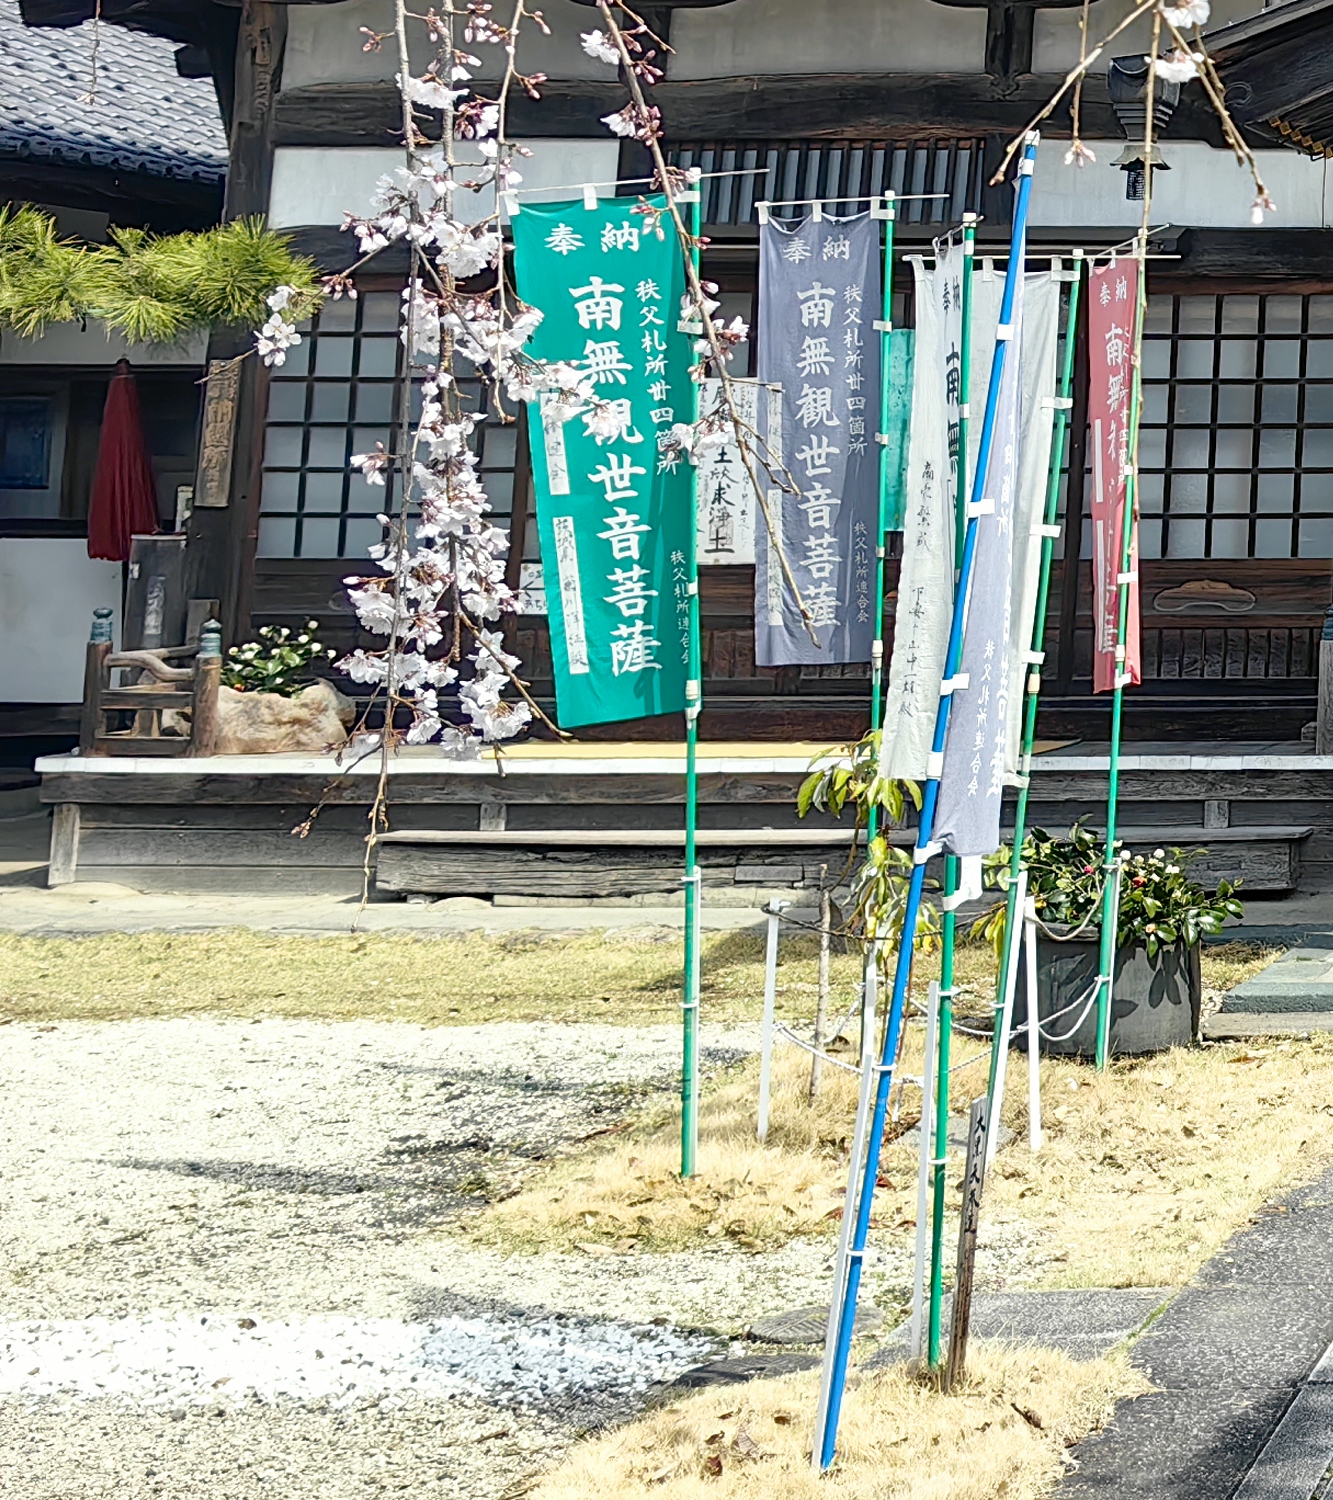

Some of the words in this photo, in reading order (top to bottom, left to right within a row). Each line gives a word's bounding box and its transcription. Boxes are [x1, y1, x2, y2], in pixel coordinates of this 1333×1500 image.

[544, 221, 641, 256] 奉納
[783, 234, 851, 265] 奉納
[794, 281, 843, 630] 南無観世音菩薩
